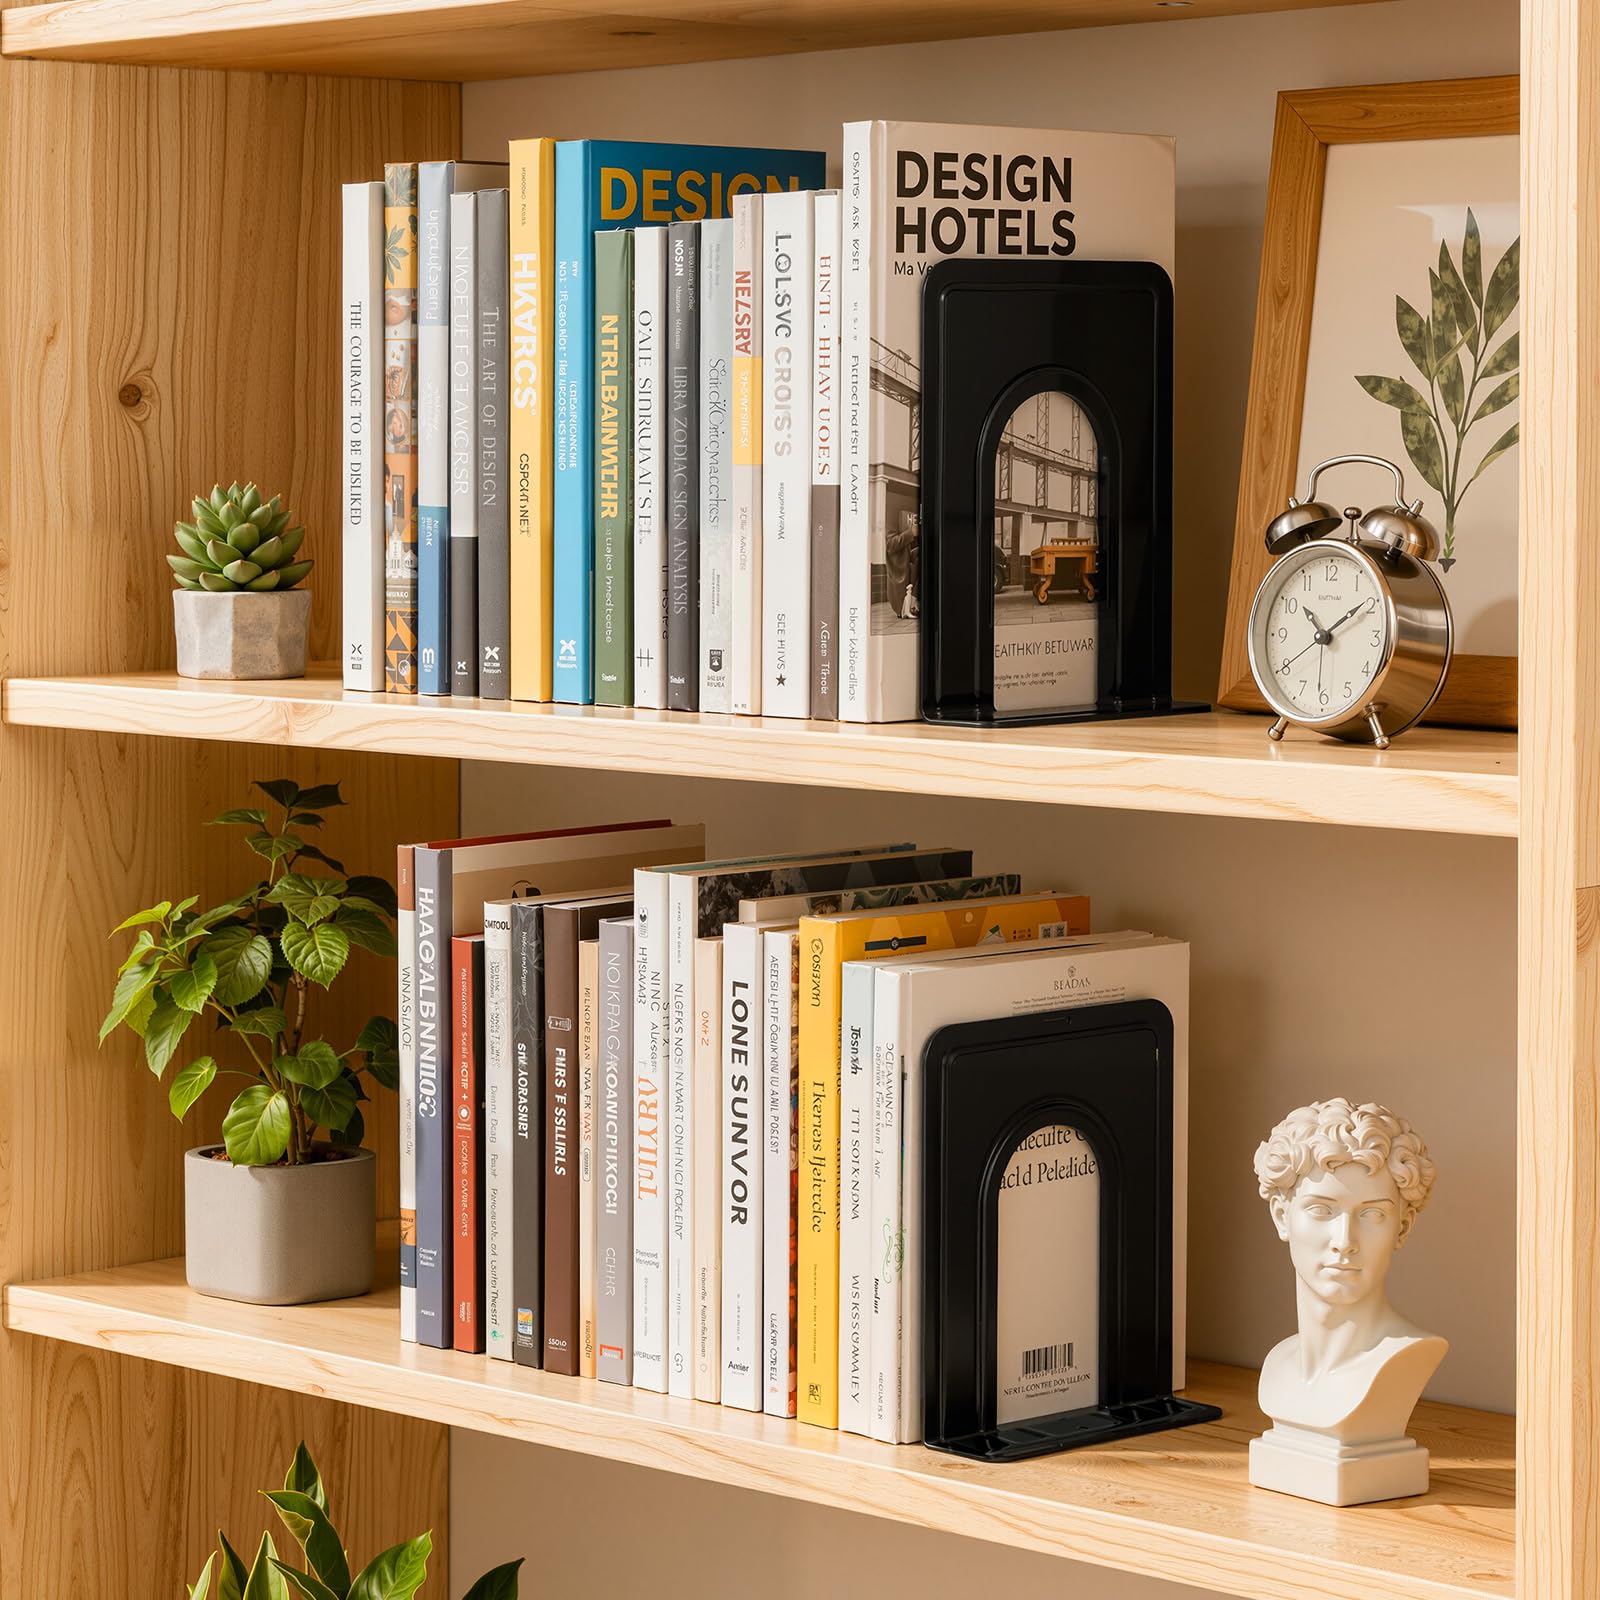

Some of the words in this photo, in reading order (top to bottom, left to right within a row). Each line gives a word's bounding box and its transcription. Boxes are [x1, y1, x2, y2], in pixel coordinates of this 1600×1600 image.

[896, 150, 1073, 203] DESIGN
[895, 205, 1077, 256] HOTELS
[893, 261, 915, 277] Ma
[350, 301, 362, 329] THE
[481, 307, 500, 348] THE
[349, 336, 362, 406] COURAGE
[482, 358, 497, 394] ART
[673, 367, 688, 410] LIBRA
[350, 413, 362, 433] TO
[482, 405, 496, 427] OF
[350, 440, 362, 456] BE
[673, 417, 688, 484] ZODIAC
[482, 437, 496, 506] DESIGN
[350, 462, 362, 525] DISLIKED
[673, 490, 688, 530] SIGN
[673, 537, 688, 615] ANALYSIS
[1303, 575, 1311, 591] 11
[1325, 565, 1338, 581] 12
[1355, 575, 1359, 592] 1
[1284, 598, 1297, 614] 10
[1366, 597, 1376, 614] 2
[1278, 628, 1287, 643] 9
[1370, 630, 1380, 647] 3
[1282, 658, 1290, 675] 8
[1362, 661, 1371, 677] 4
[1299, 680, 1307, 696] 7
[1319, 689, 1329, 705] 6
[1343, 682, 1352, 698] 5
[731, 980, 749, 1067] LONE
[730, 1074, 749, 1225] SUNVOR
